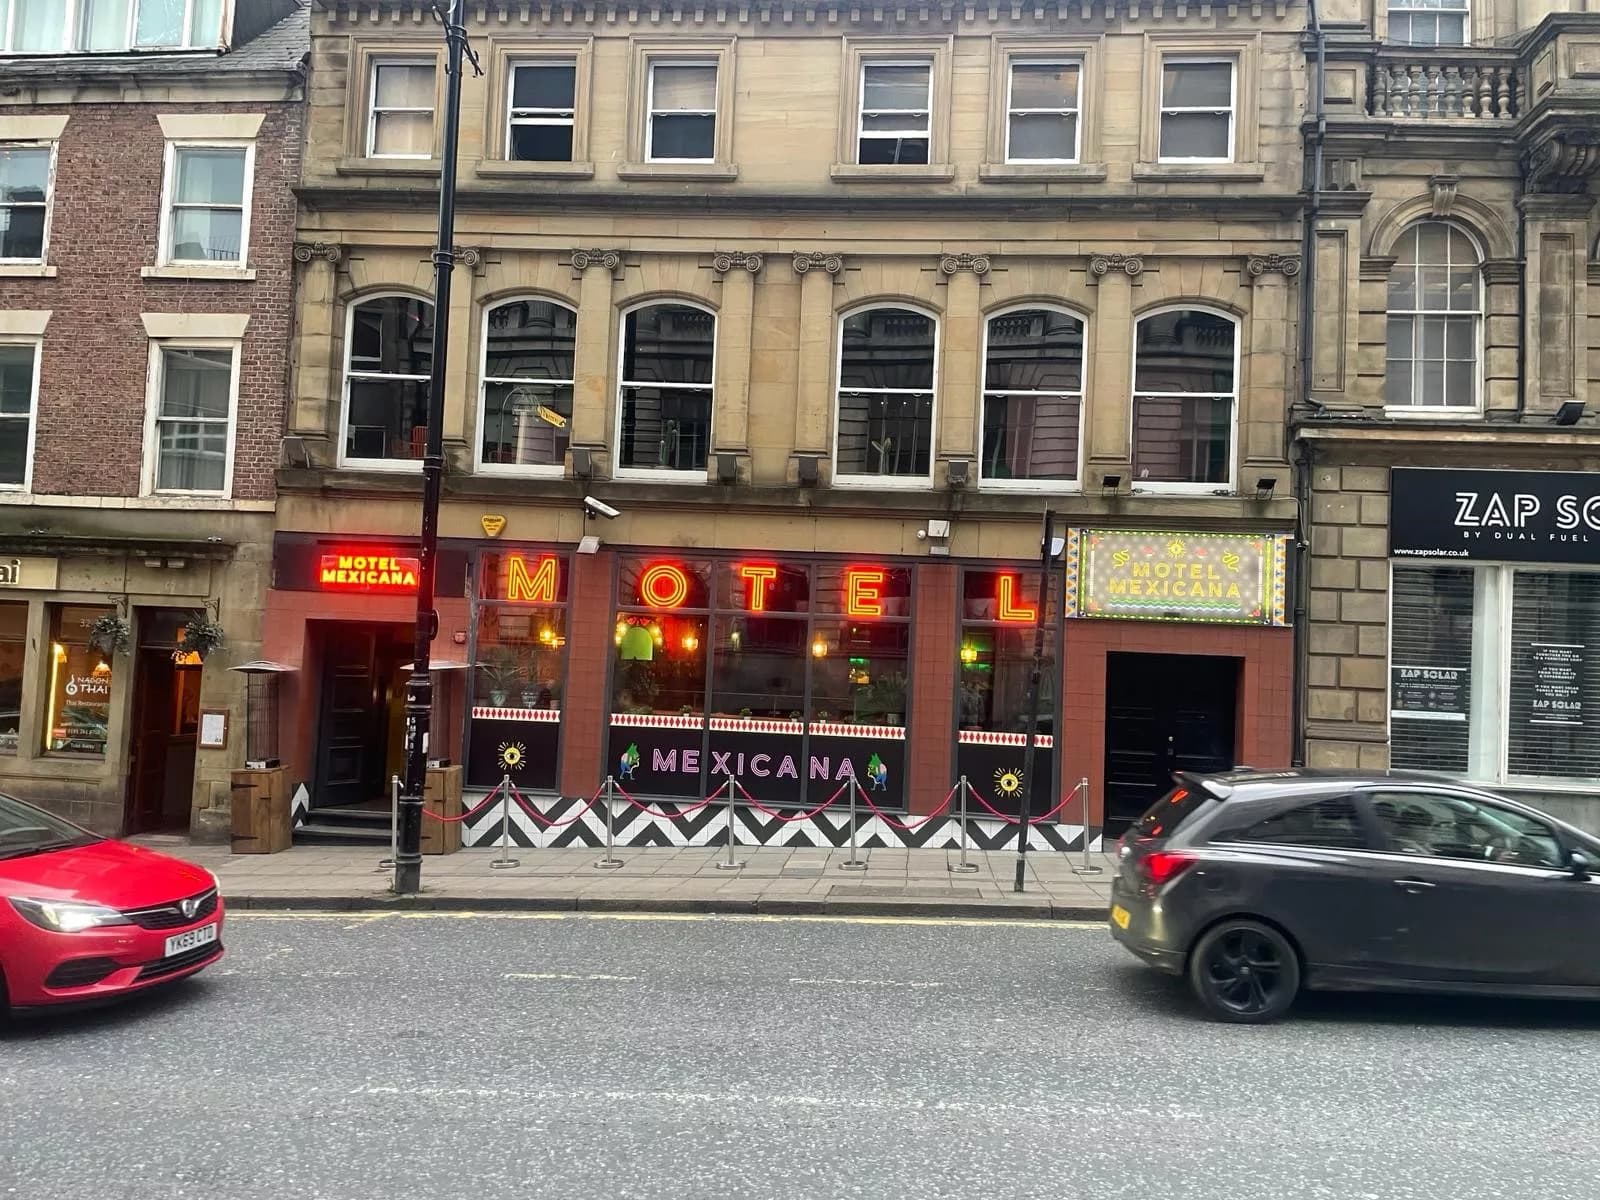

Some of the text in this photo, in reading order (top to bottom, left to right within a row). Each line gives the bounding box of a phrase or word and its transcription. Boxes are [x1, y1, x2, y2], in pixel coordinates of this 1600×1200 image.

[1454, 491, 1540, 528] ZAP
[1463, 531, 1589, 542] BY DUAL FUEL
[1393, 548, 1469, 557] www.zapsolar.co.uk
[339, 556, 400, 571] MOTEL
[1132, 562, 1221, 580] MOTEL
[322, 569, 416, 585] MEXICANA
[507, 555, 1036, 622] MOTEL
[1108, 578, 1241, 598] MEXICANA
[1400, 669, 1421, 678] ZAP
[1423, 670, 1458, 680] SOLAR
[80, 684, 108, 695] THAI
[1532, 700, 1582, 710] ZAP SOLAR
[652, 748, 856, 781] MEXICANA
